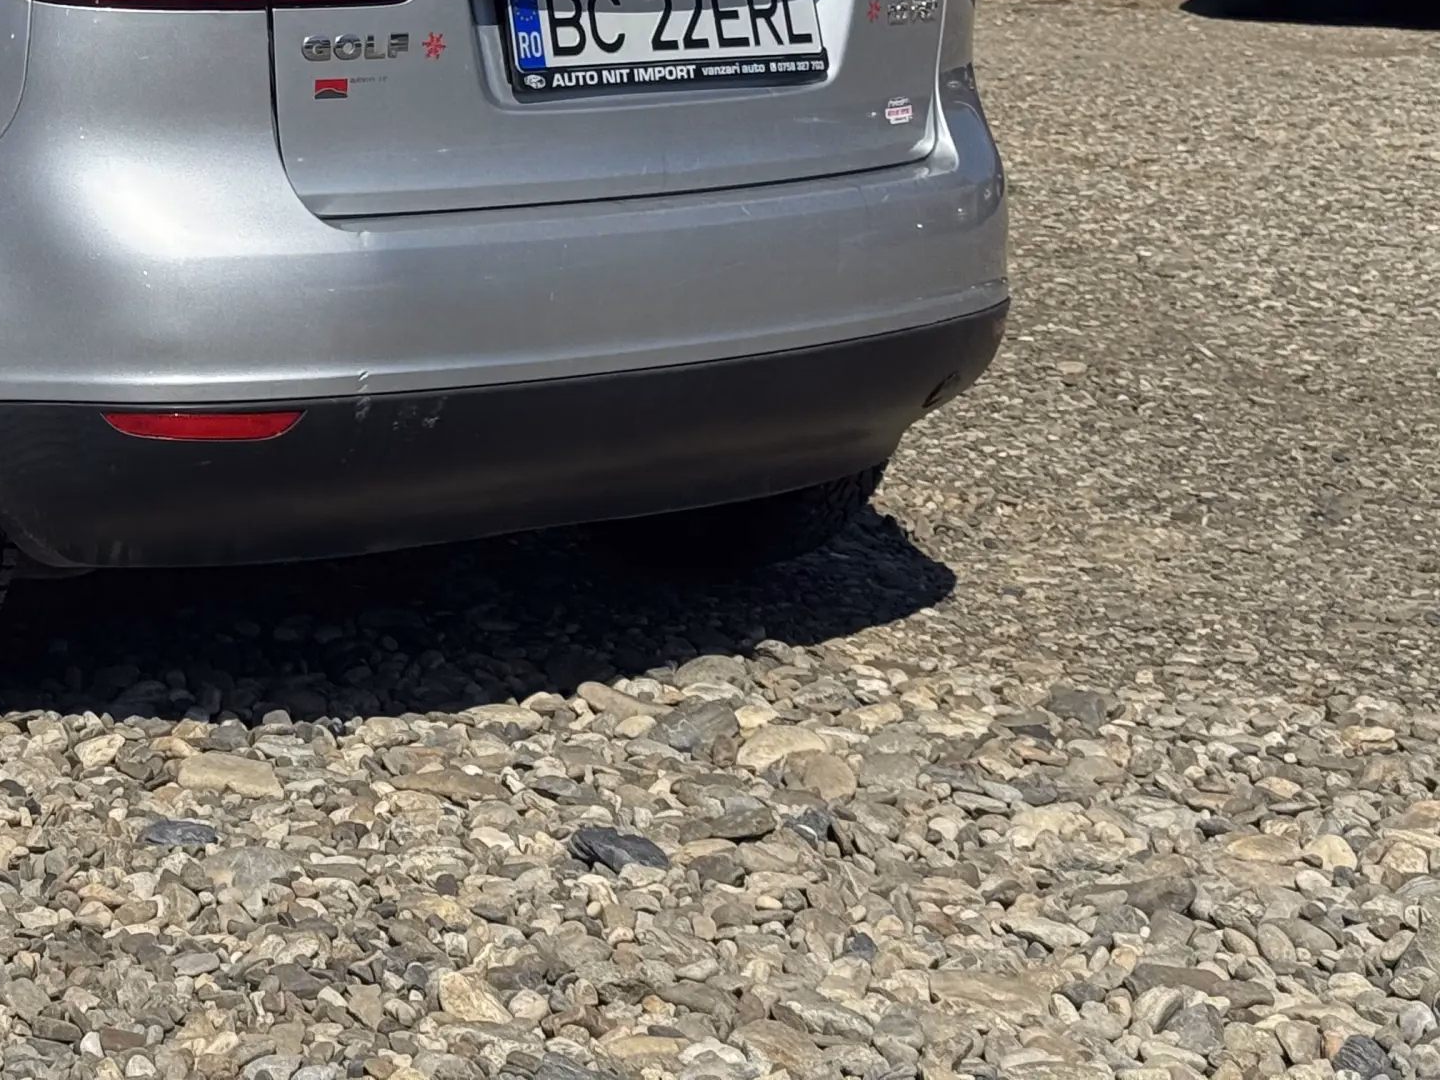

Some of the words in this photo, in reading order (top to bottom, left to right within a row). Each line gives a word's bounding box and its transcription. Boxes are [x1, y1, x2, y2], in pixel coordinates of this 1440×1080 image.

[301, 32, 409, 62] GOLF
[520, 31, 542, 59] RO
[552, 71, 598, 88] AUTO
[602, 69, 630, 84] NIT
[633, 65, 696, 82] IMPORT
[701, 63, 741, 76] vanzari
[741, 63, 766, 74] auto
